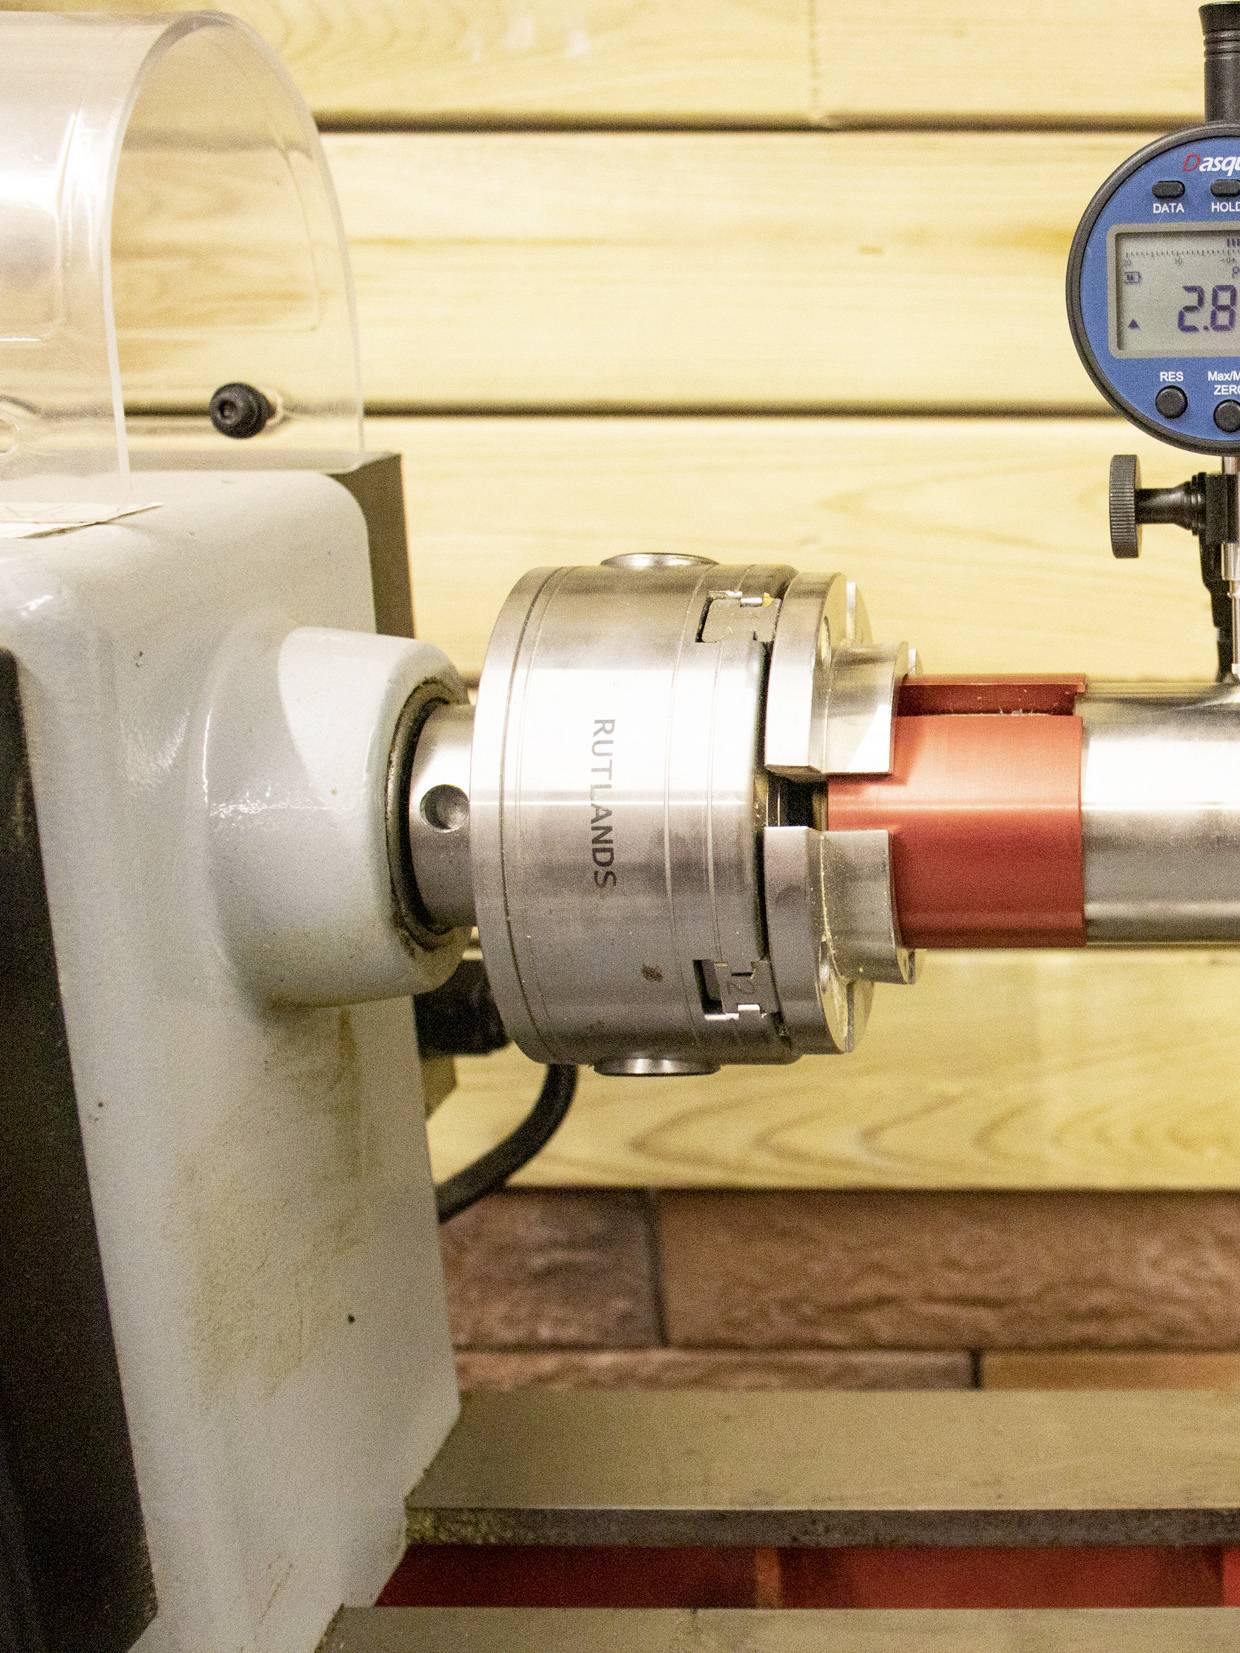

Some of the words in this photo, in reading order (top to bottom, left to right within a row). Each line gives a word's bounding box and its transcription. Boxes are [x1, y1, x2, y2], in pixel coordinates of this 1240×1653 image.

[1153, 203, 1185, 214] DATA
[1160, 371, 1184, 382] RES
[590, 719, 617, 888] RUTLANDS
